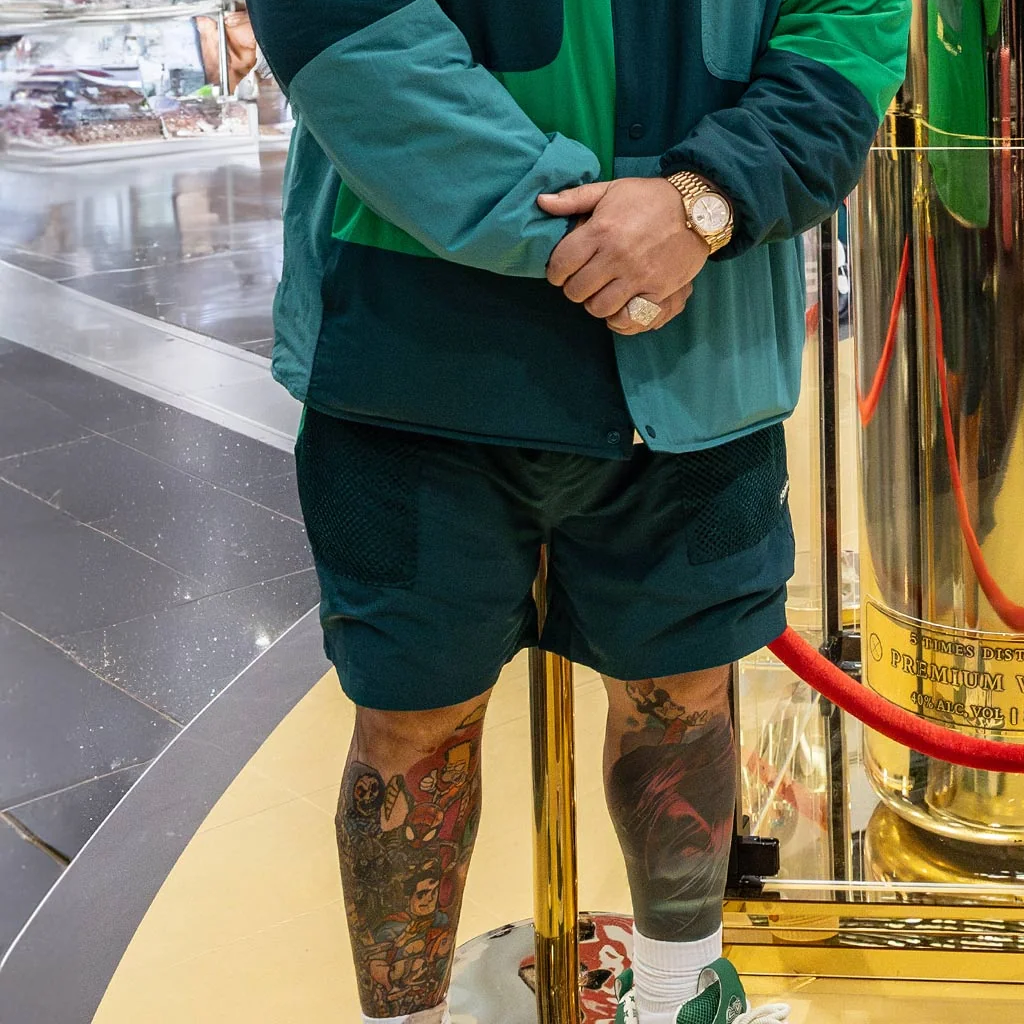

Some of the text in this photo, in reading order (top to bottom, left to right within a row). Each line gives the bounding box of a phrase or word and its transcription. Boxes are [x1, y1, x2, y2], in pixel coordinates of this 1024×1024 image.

[910, 632, 918, 645] 5
[922, 636, 975, 658] TIMES
[891, 648, 1005, 692] PREMIUM
[910, 691, 934, 709] 40%
[970, 705, 1004, 720] VOL
